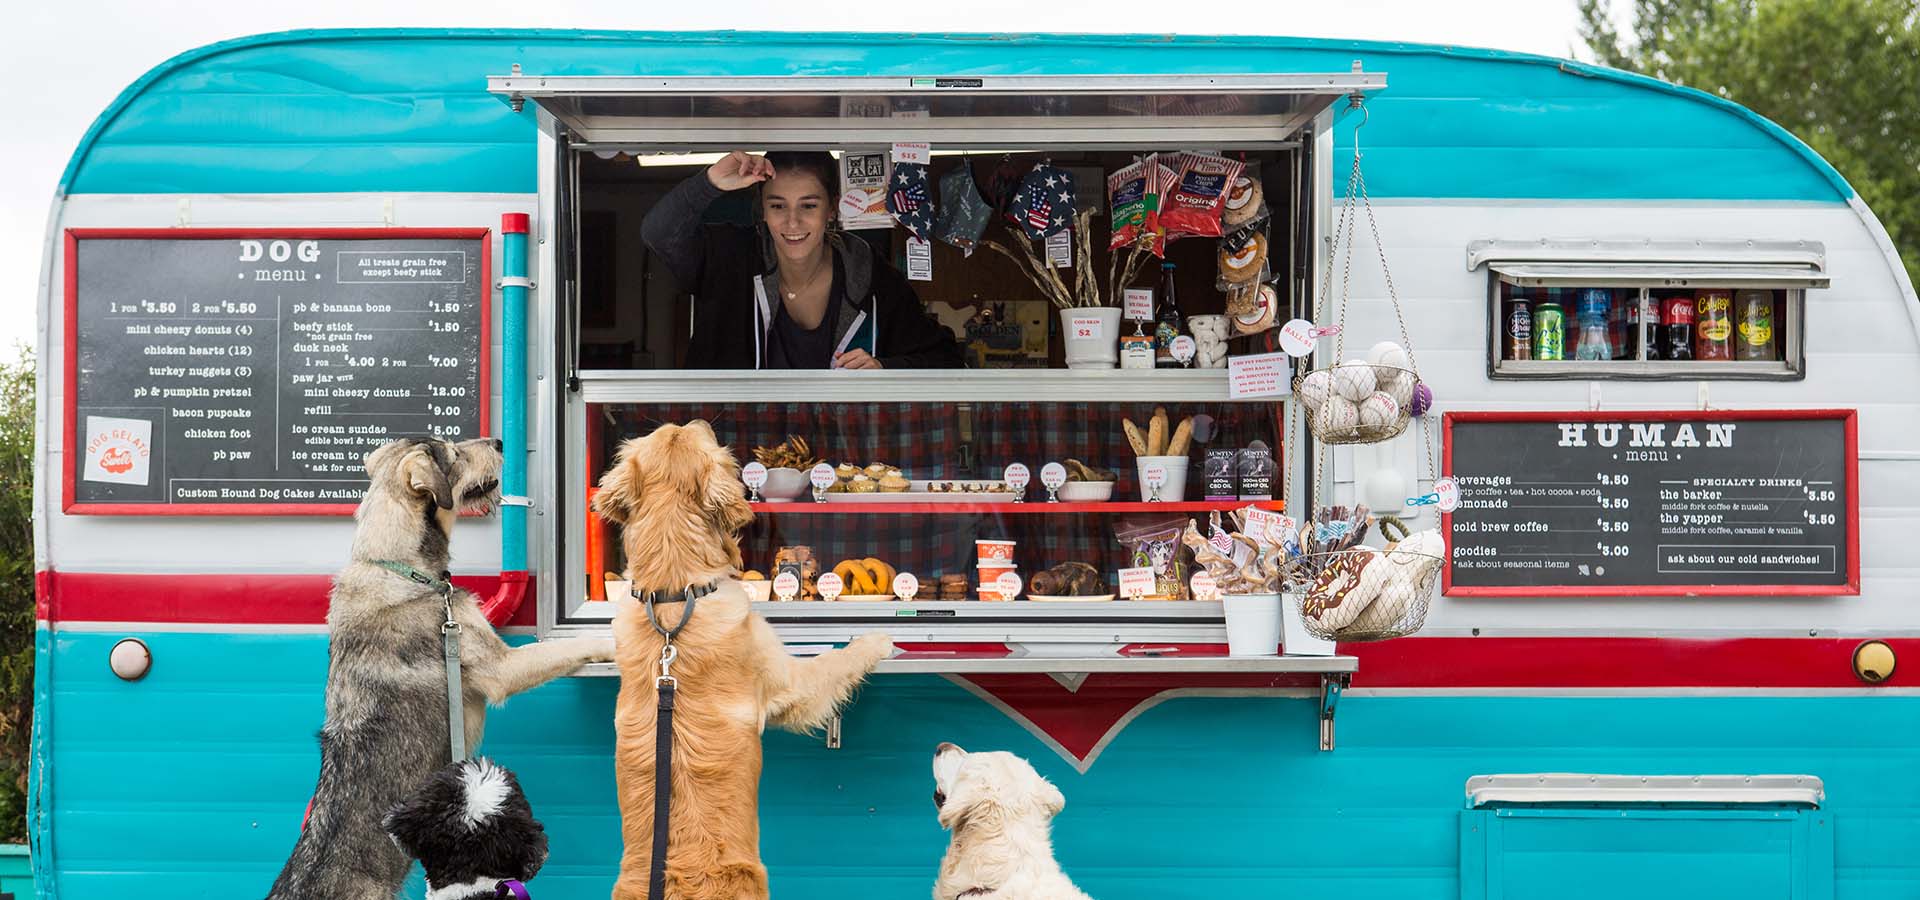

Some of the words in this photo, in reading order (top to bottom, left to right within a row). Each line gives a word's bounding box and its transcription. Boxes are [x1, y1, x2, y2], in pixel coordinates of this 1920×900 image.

[867, 166, 881, 176] CAT
[1175, 193, 1218, 208] Original
[239, 240, 320, 262] DOG
[358, 258, 371, 267] All
[373, 258, 400, 267] treats
[402, 258, 426, 268] grain
[428, 258, 447, 267] free
[254, 269, 307, 281] menu
[363, 269, 392, 278] except
[393, 268, 418, 278] beefy
[420, 268, 442, 277] stick
[110, 302, 117, 313] 1
[141, 300, 177, 314] $3.50
[192, 302, 200, 313] 2
[222, 300, 257, 314] $5.50
[293, 303, 307, 314] pb
[310, 303, 320, 312] &
[323, 303, 363, 312] banana
[366, 303, 392, 312] bone
[428, 301, 460, 313] $1.50
[126, 325, 150, 334] mini
[154, 325, 191, 336] cheezy
[195, 325, 232, 334] donuts
[234, 325, 253, 336] (4)
[293, 322, 323, 333] beefy
[326, 322, 354, 332] stick
[428, 320, 460, 332] $1.50
[1078, 328, 1091, 337] $2
[328, 333, 352, 342] grain
[354, 333, 373, 341] free
[144, 346, 186, 355] chicken
[189, 346, 225, 355] hearts
[228, 346, 253, 356] (12)
[293, 344, 320, 353] duck
[322, 344, 349, 353] neck
[304, 357, 312, 367] 1
[344, 354, 375, 368] $4.00
[382, 358, 389, 367] 2
[428, 354, 458, 368] $7.00
[149, 367, 185, 378] turkey
[188, 367, 231, 378] nuggets
[234, 366, 252, 377] (3)
[292, 374, 314, 384] paw
[317, 373, 334, 384] jar
[134, 388, 148, 398] pb
[150, 387, 161, 397] &
[164, 387, 210, 398] pumpkin
[212, 387, 252, 398] pretzel
[304, 388, 329, 397] mini
[332, 388, 370, 399] cheezy
[374, 388, 410, 397] donuts
[428, 384, 466, 397] $12.00
[172, 408, 204, 418] bacon
[207, 408, 252, 420] pupcake
[304, 406, 332, 415] refill
[428, 404, 461, 416] $9.00
[184, 429, 226, 438] chicken
[230, 429, 251, 438] foot
[292, 425, 308, 434] ice
[311, 426, 344, 434] cream
[348, 425, 387, 434] sundae
[427, 424, 461, 436] $5.00
[1558, 423, 1736, 447] HUMAN
[88, 433, 108, 454] DOG
[112, 430, 149, 457] GELATO
[304, 437, 331, 445] edible
[334, 437, 354, 445] bowl
[356, 437, 364, 445] &
[366, 437, 397, 446] toppin
[214, 450, 226, 461] pb
[230, 451, 251, 461] paw
[292, 451, 308, 460] ice
[311, 452, 344, 460] cream
[348, 451, 360, 460] to
[1626, 451, 1668, 462] menu
[312, 464, 328, 472] ask
[330, 464, 344, 472] for
[1453, 474, 1512, 487] beverages
[1597, 473, 1629, 486] $2.50
[1694, 478, 1756, 486] SPECIALTY
[1760, 478, 1802, 486] DRINKS
[177, 488, 218, 498] Custom
[221, 488, 256, 498] Hound
[260, 488, 279, 500] Dog
[283, 488, 315, 498] Cakes
[318, 488, 368, 498] Available
[1435, 482, 1452, 494] TOY
[1459, 488, 1474, 497] rip
[1476, 488, 1502, 496] coffee
[1510, 488, 1524, 496] tea
[1531, 488, 1546, 496] hot
[1581, 488, 1602, 496] soda
[1660, 490, 1679, 500] the
[1683, 490, 1722, 500] barker
[1804, 486, 1836, 501] $3.50
[1457, 499, 1508, 509] emonade
[1597, 496, 1629, 509] $3.50
[1662, 503, 1688, 511] middle
[1690, 503, 1706, 511] fork
[1708, 503, 1731, 511] coffee
[1732, 503, 1740, 511] &
[1742, 503, 1768, 511] nutella
[1660, 514, 1679, 524] the
[1682, 515, 1724, 526] yapper
[1804, 510, 1836, 525] $3.50
[1454, 522, 1477, 532] cold
[1482, 522, 1510, 532] brew
[1514, 522, 1548, 532] coffee
[1597, 518, 1629, 532] $3.50
[1662, 526, 1688, 534] middle
[1690, 526, 1706, 534] fork
[1708, 526, 1733, 536] coffee,
[1734, 526, 1766, 534] caramel
[1768, 526, 1775, 534] &
[1776, 526, 1803, 534] vanilla
[1454, 546, 1497, 558] goodies
[1597, 542, 1629, 556] $3.00
[1476, 560, 1502, 568] about
[1504, 560, 1542, 568] seasonal
[1544, 560, 1570, 568] items
[1668, 554, 1685, 564] ask
[1688, 554, 1715, 564] about
[1718, 556, 1735, 564] our
[1738, 554, 1758, 564] cold
[1760, 554, 1820, 564] sandwiches!
